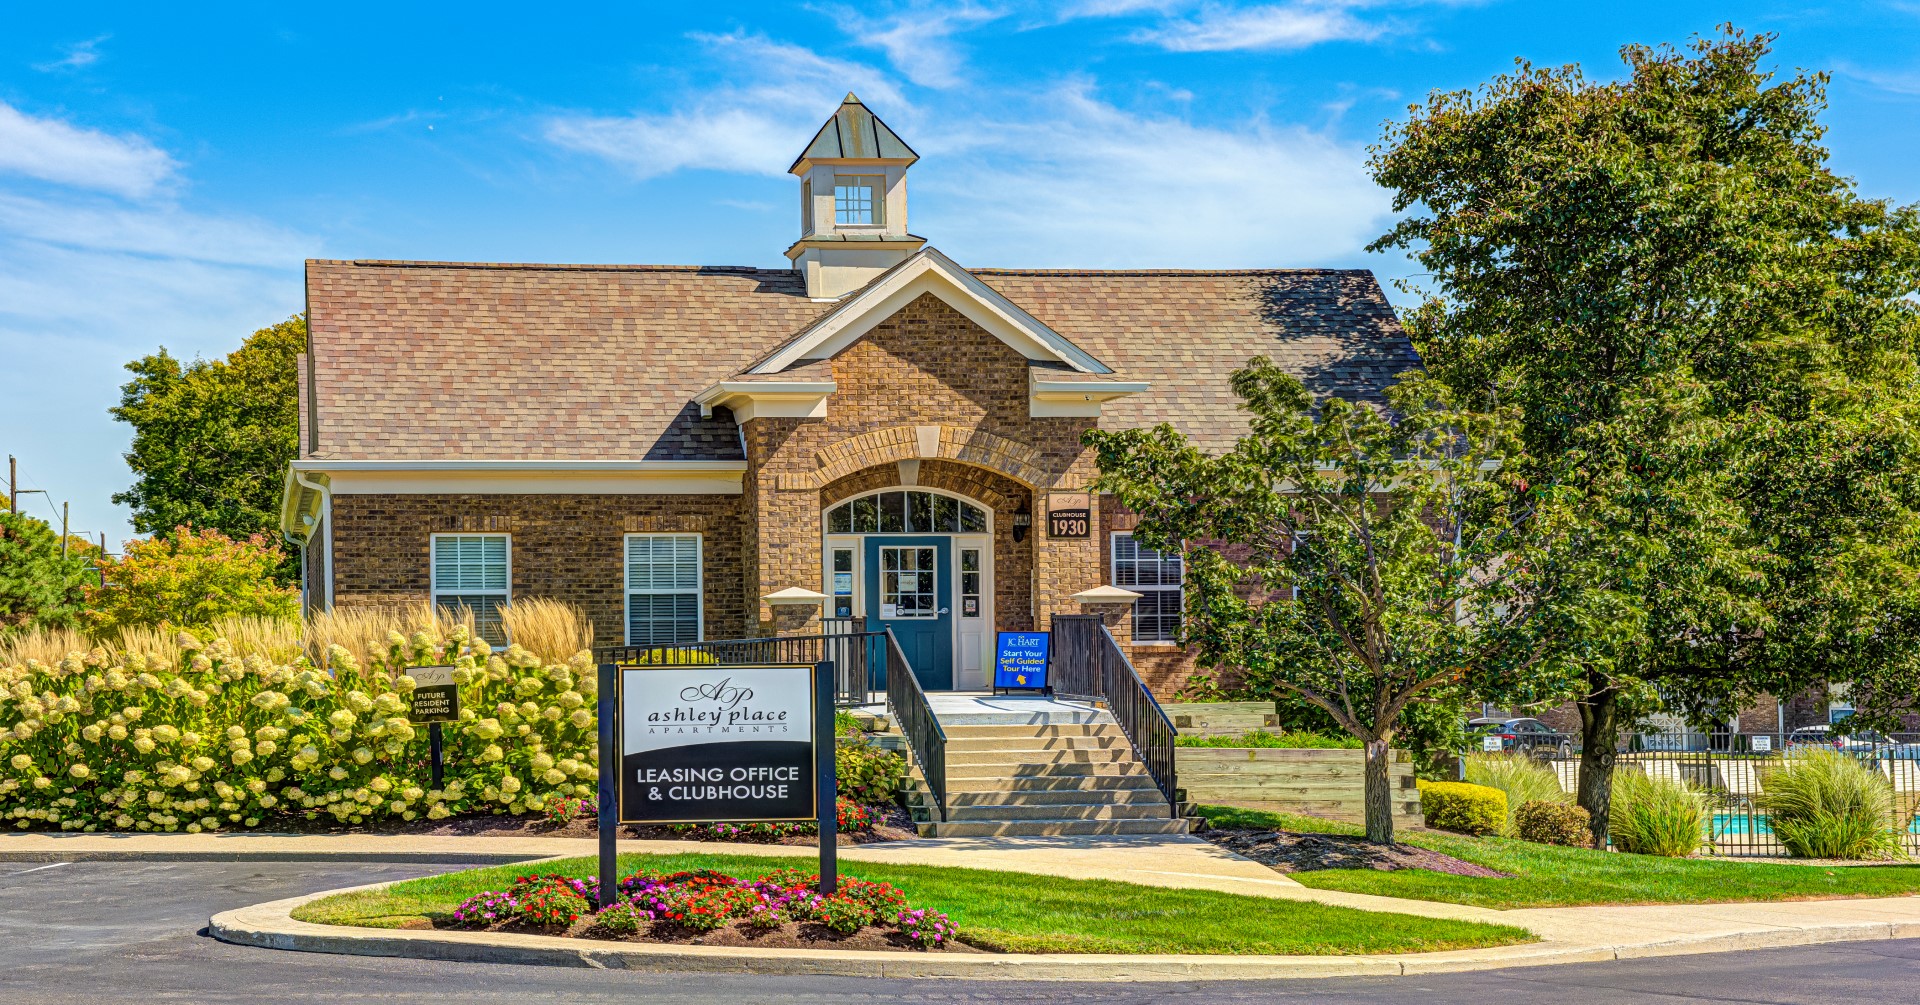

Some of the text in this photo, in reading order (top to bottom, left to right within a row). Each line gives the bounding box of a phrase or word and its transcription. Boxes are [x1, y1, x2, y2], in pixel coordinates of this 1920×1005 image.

[1052, 520, 1086, 535] 1930
[1018, 638, 1040, 646] HART
[1000, 657, 1045, 665] Self Guided
[414, 699, 450, 707] RESIDENT
[415, 707, 450, 715] PARKING
[648, 707, 787, 726] ashley place
[649, 725, 788, 734] APARTMENTS
[637, 767, 799, 783] LEASING OFFICE
[648, 784, 789, 800] & CLUBHOUSE
